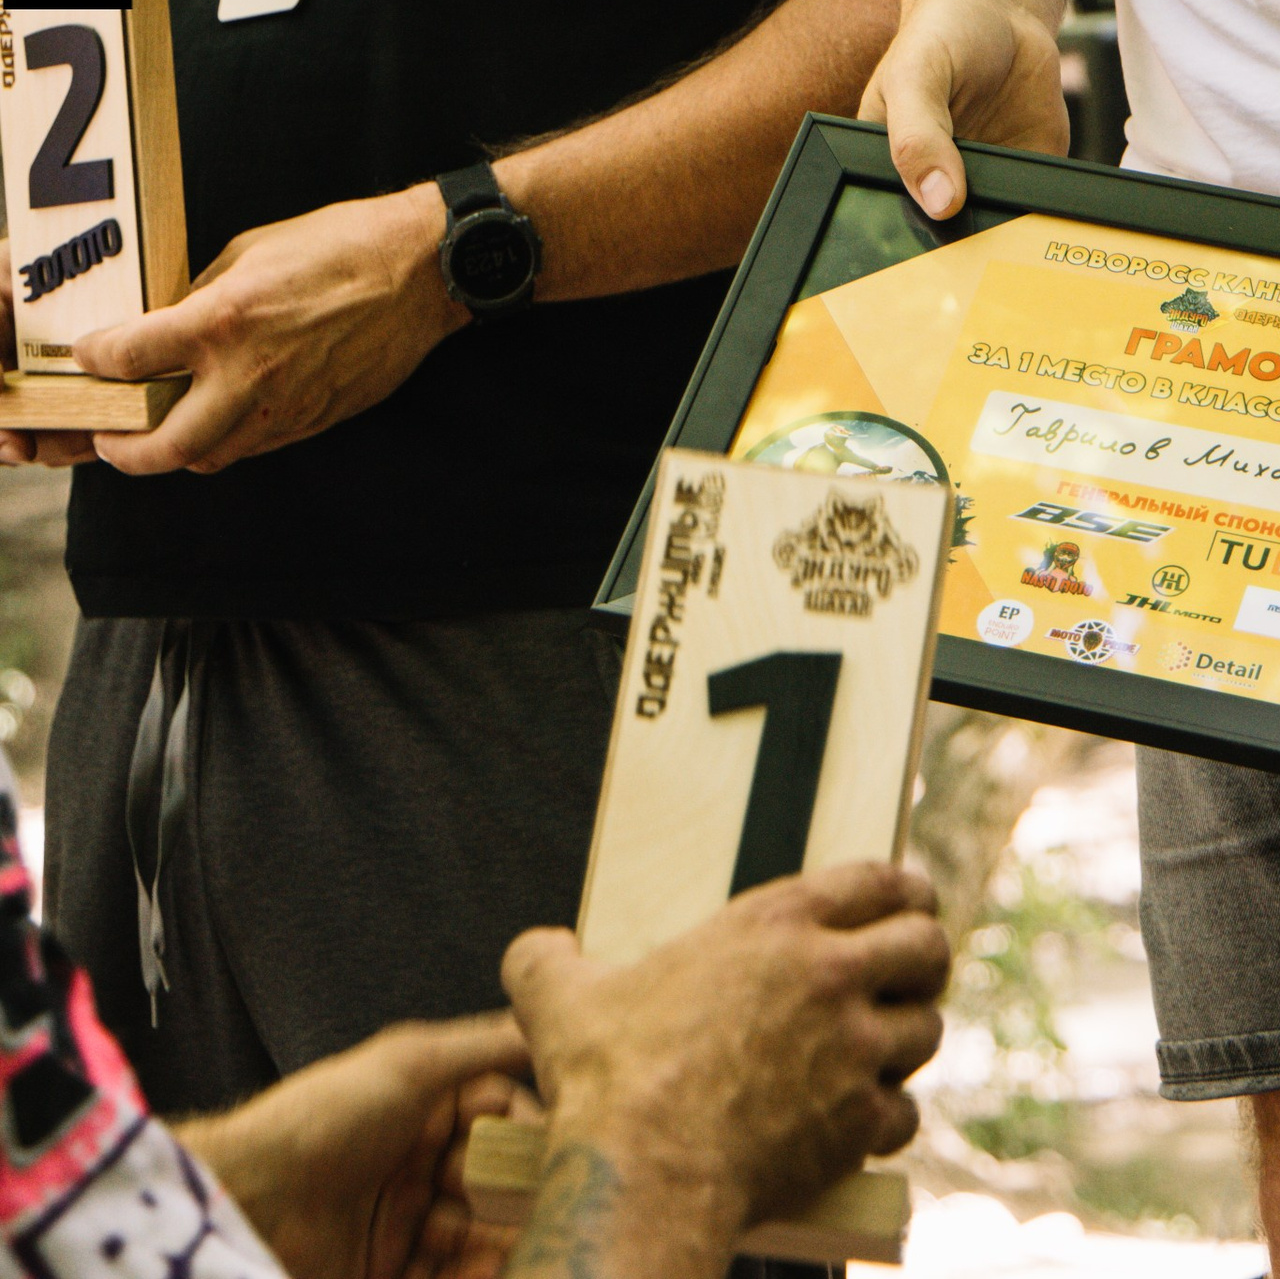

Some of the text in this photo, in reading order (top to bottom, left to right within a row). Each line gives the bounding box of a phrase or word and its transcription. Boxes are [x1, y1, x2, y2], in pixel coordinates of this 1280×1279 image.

[23, 24, 114, 209] 2
[1044, 241, 1210, 288] НОВОРОСС
[968, 342, 1011, 370] ЗА
[1018, 352, 1034, 373] 1
[1036, 355, 1148, 395] МЕСТО
[1151, 377, 1173, 400] В
[1012, 501, 1173, 544] BSE
[1056, 480, 1210, 523] ГЕНЕРАЛЬНЫЙ
[1220, 538, 1271, 571] TU
[998, 605, 1020, 620] EP
[1050, 629, 1081, 642] MOTO
[1196, 653, 1263, 680] Detail
[707, 651, 843, 901] 1
